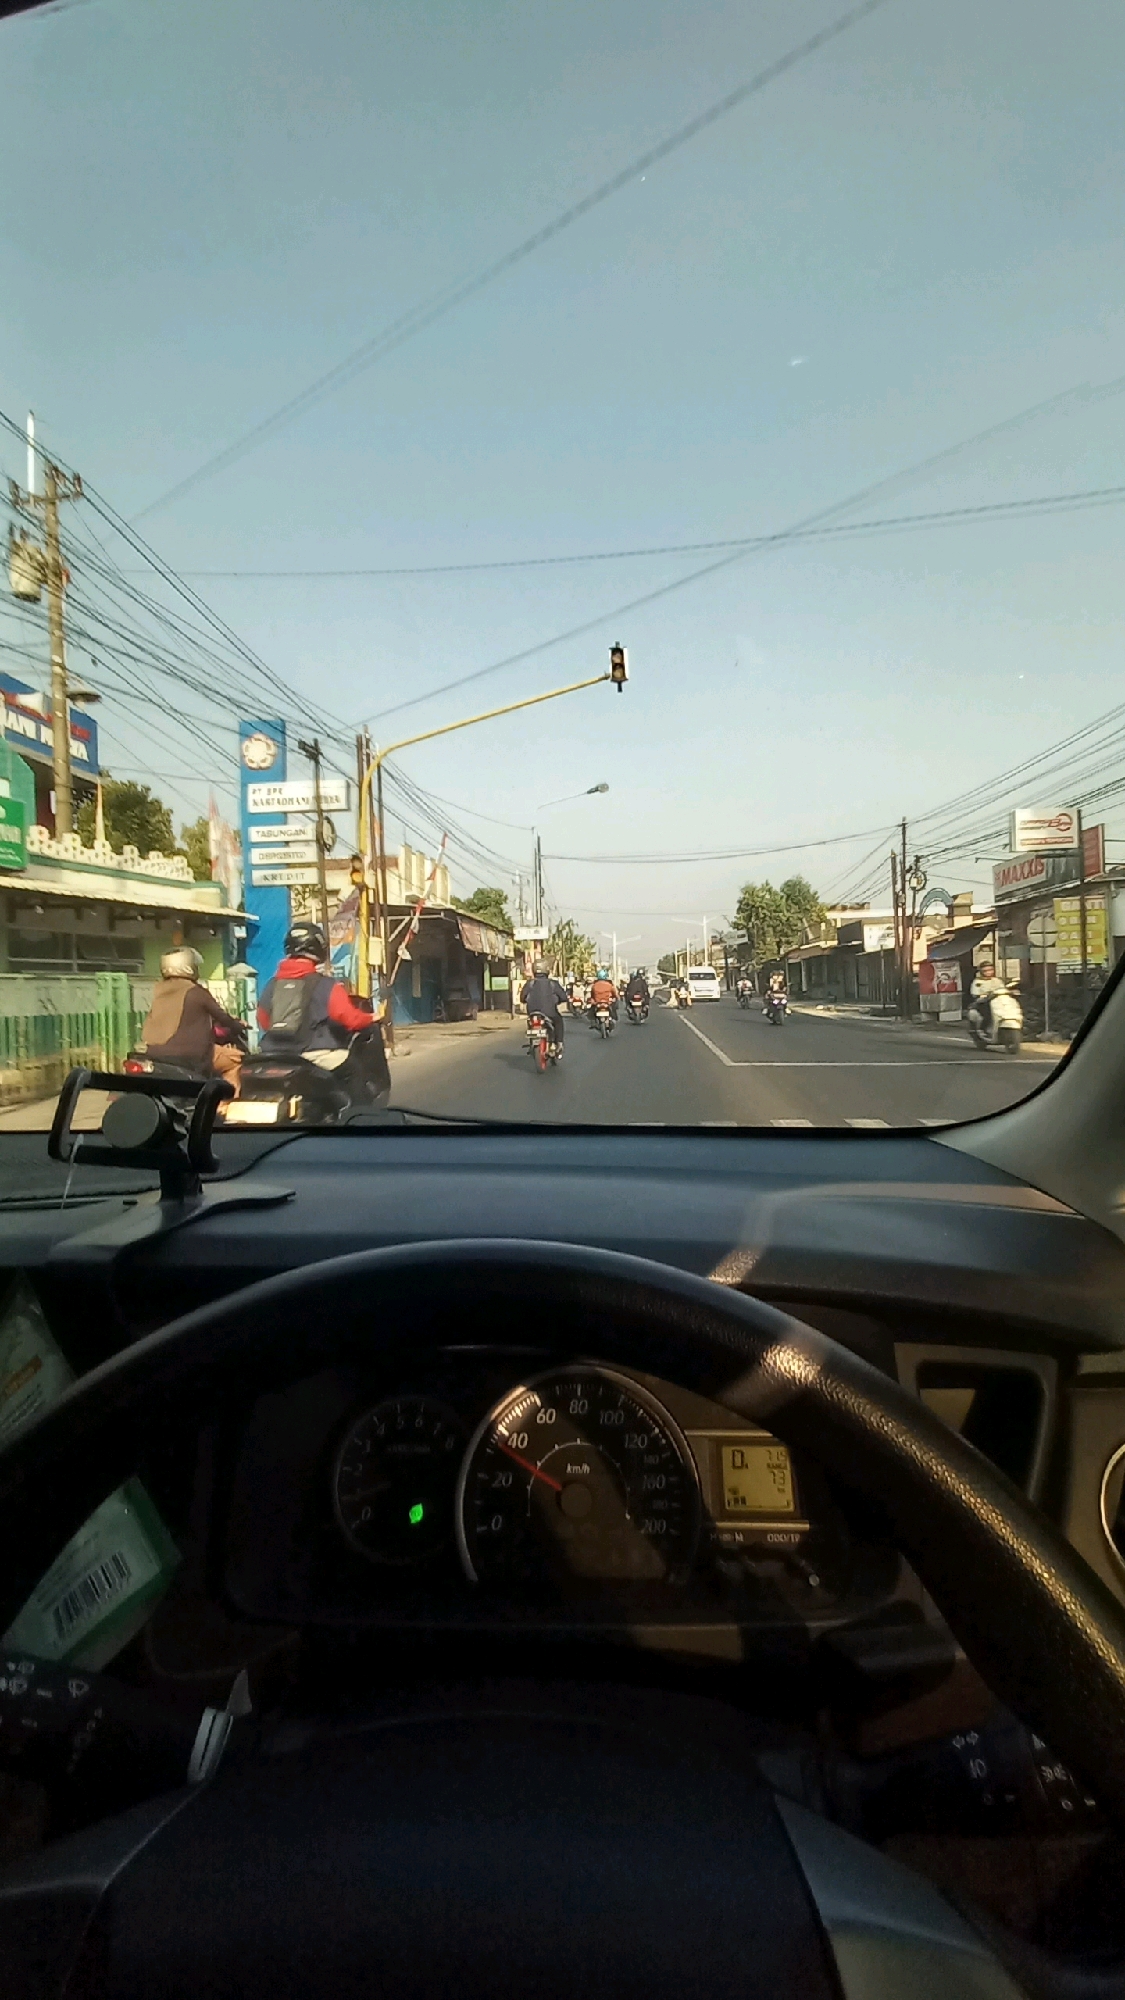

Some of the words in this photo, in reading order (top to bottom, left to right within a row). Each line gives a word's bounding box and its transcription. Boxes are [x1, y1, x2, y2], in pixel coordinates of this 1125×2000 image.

[255, 829, 306, 838] TABUNGAN
[262, 872, 306, 882] KREDIT
[1001, 857, 1045, 887] MAXXIS
[569, 1399, 589, 1415] 80
[536, 1408, 557, 1425] 60
[599, 1409, 625, 1425] 100
[507, 1432, 529, 1449] 40
[624, 1434, 648, 1449] 120
[565, 1462, 591, 1475] km/h
[491, 1471, 513, 1488] 20
[642, 1474, 666, 1490] 160
[491, 1514, 503, 1531] 0
[643, 1518, 667, 1534] 200
